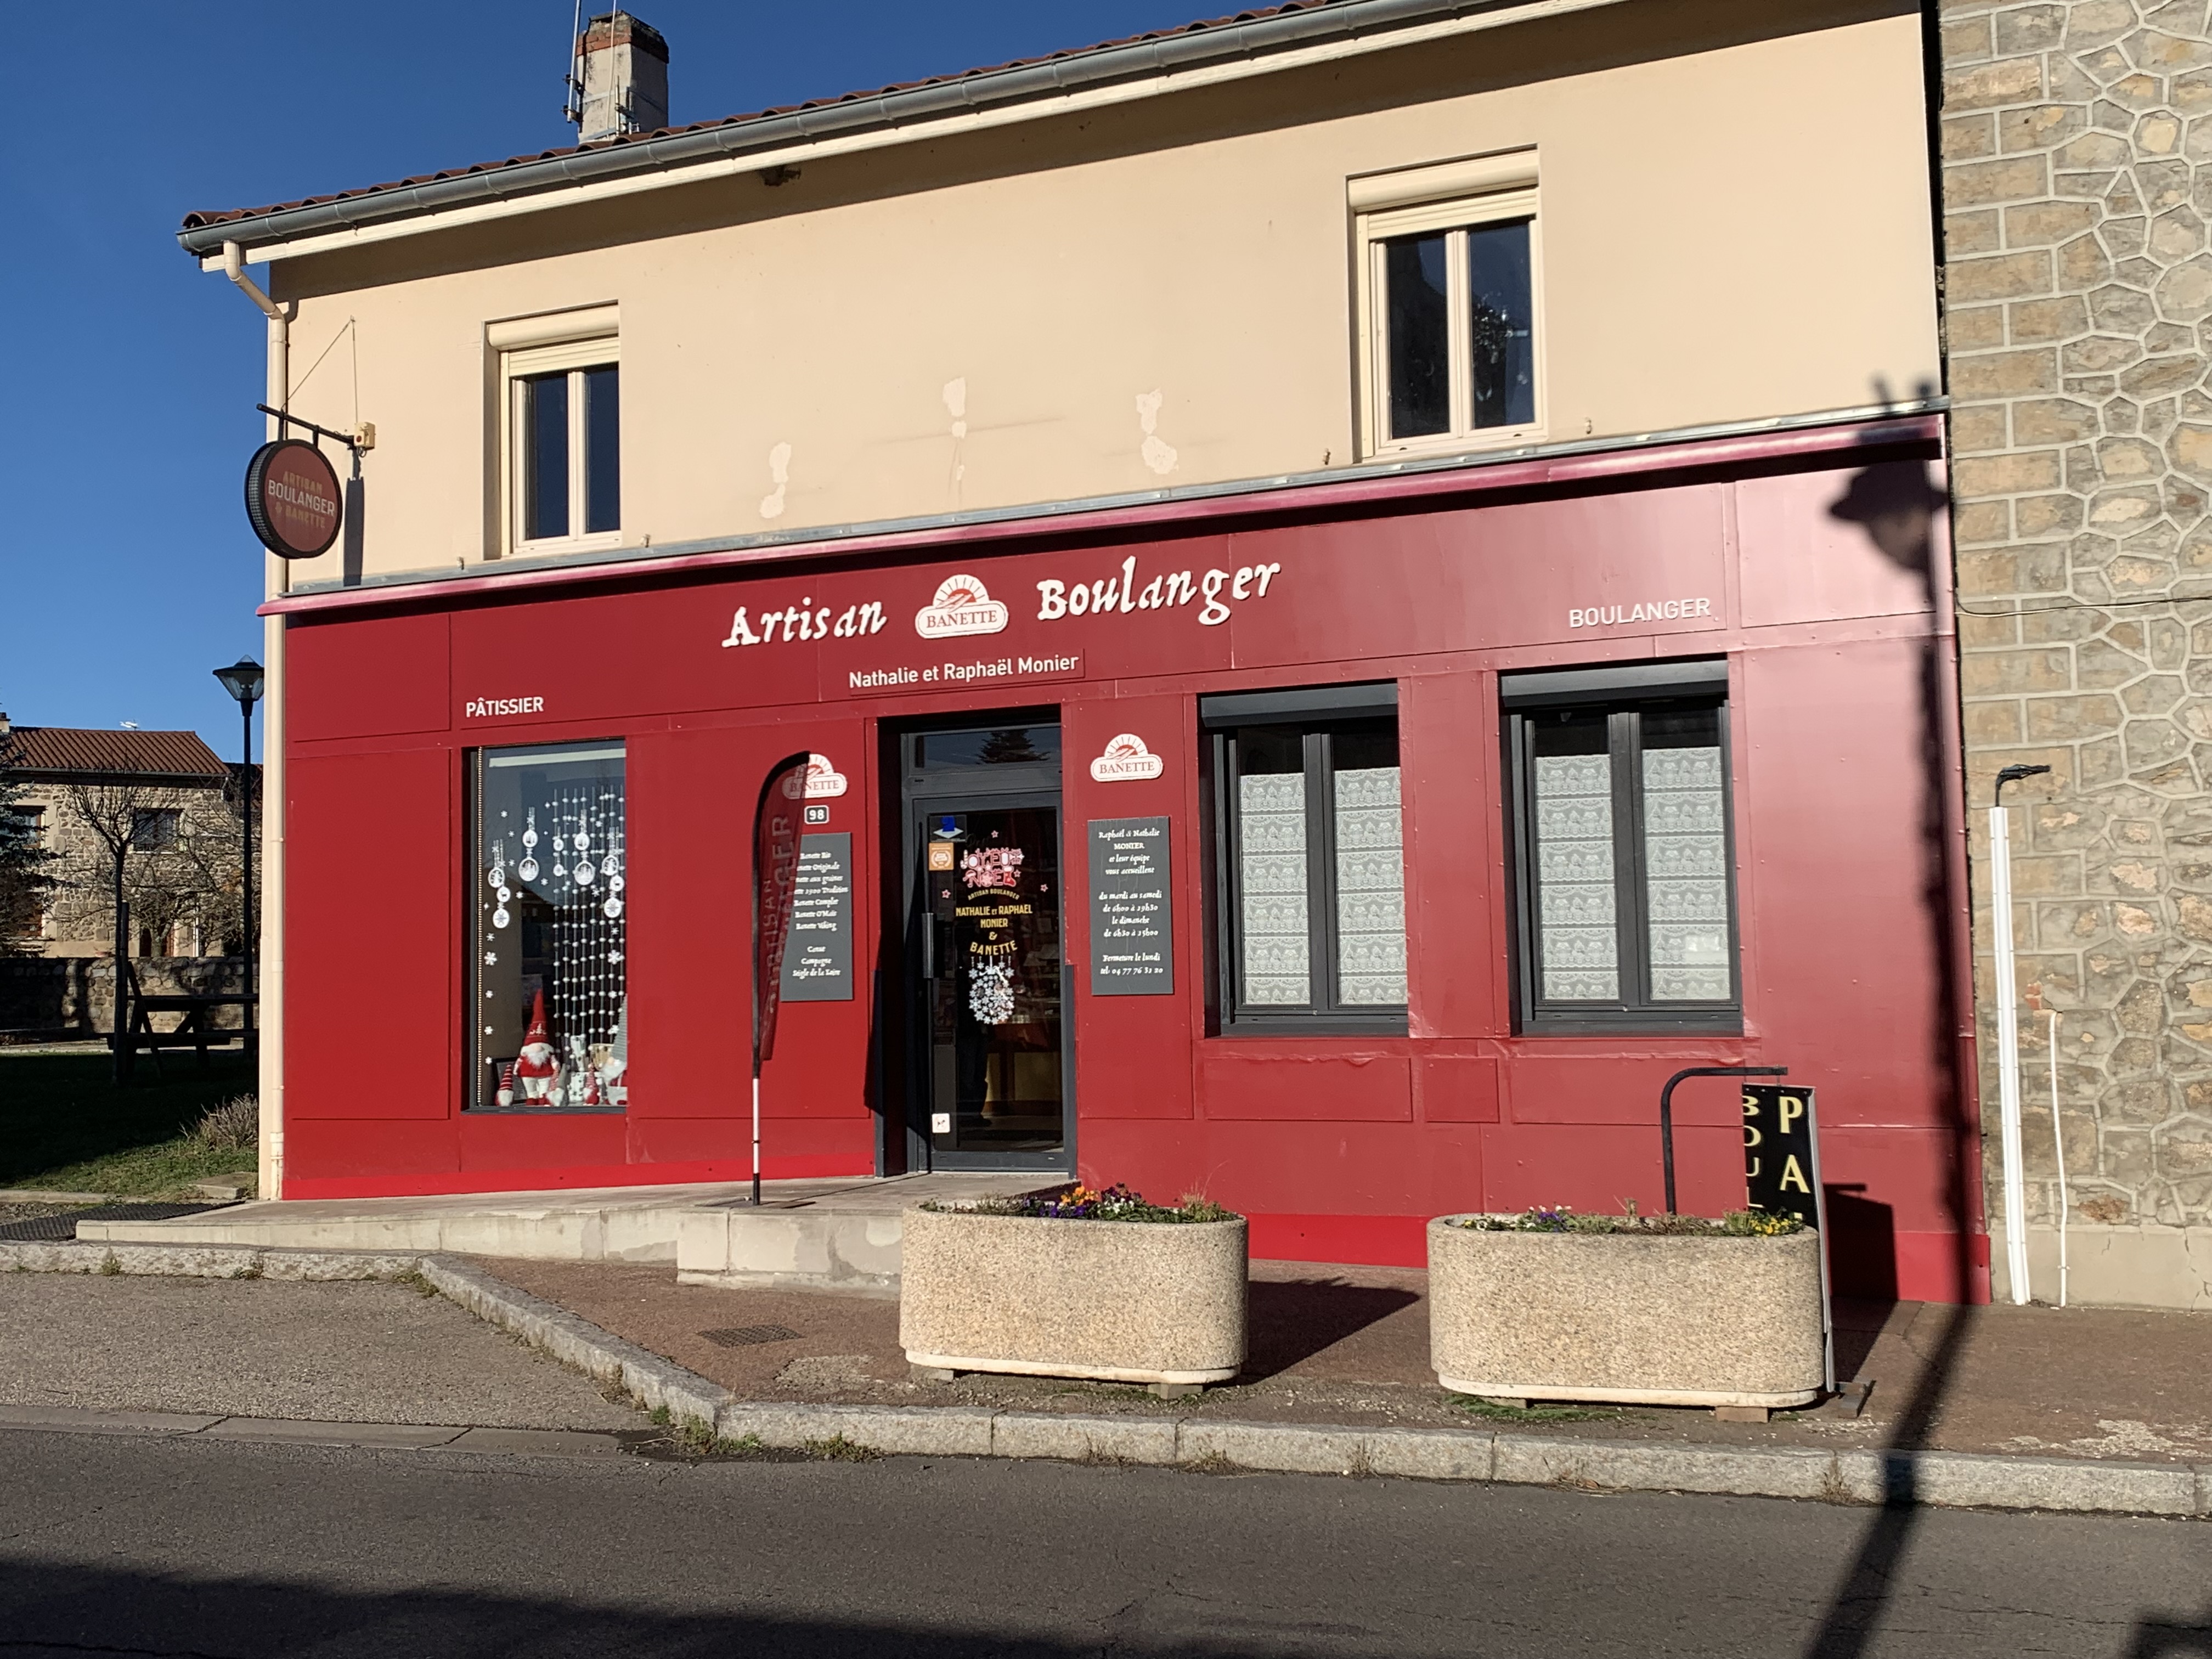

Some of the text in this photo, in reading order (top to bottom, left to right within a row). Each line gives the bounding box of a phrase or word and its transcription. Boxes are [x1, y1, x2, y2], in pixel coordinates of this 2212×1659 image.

[283, 471, 323, 493] ARTISAN
[268, 479, 335, 516] BOULANGER
[285, 505, 325, 528] BANETTE
[721, 555, 1281, 648] Artisan Boulanger
[1568, 597, 1711, 628] BOULANGER
[926, 610, 997, 628] BANETTE
[849, 654, 1079, 689] Nathalie et Raphaël Monier
[466, 697, 544, 718] PÂTISSIER
[1099, 761, 1155, 774] BANETTE
[809, 809, 825, 821] 98
[1098, 828, 1125, 841] Raphaël
[1133, 827, 1160, 837] Nathalie
[1115, 854, 1130, 862] leur
[1130, 854, 1150, 865] équipe
[1121, 865, 1155, 874] accueillent
[967, 888, 1020, 900] ARTISAN BOULANGER
[1098, 891, 1108, 900] du
[1109, 890, 1128, 899] mardi
[1139, 889, 1162, 899] samedi
[955, 906, 991, 917] NATHALIE
[998, 904, 1033, 915] RAPHAEL
[1103, 904, 1111, 912] de
[1112, 903, 1130, 912] 6h00
[1137, 902, 1159, 912] 19h30
[980, 918, 1008, 928] MONIER
[1111, 915, 1150, 924] le dimanche
[989, 931, 998, 940] &
[1103, 928, 1112, 937] de
[1113, 928, 1130, 937] 6h30
[1137, 927, 1159, 937] 15h00
[969, 940, 1018, 955] BANETTE
[1135, 952, 1141, 961] le
[1142, 952, 1161, 961] lundi
[809, 968, 817, 976] de
[817, 967, 825, 976] la
[1133, 967, 1143, 975] 76
[1779, 1096, 1810, 1219] PA
